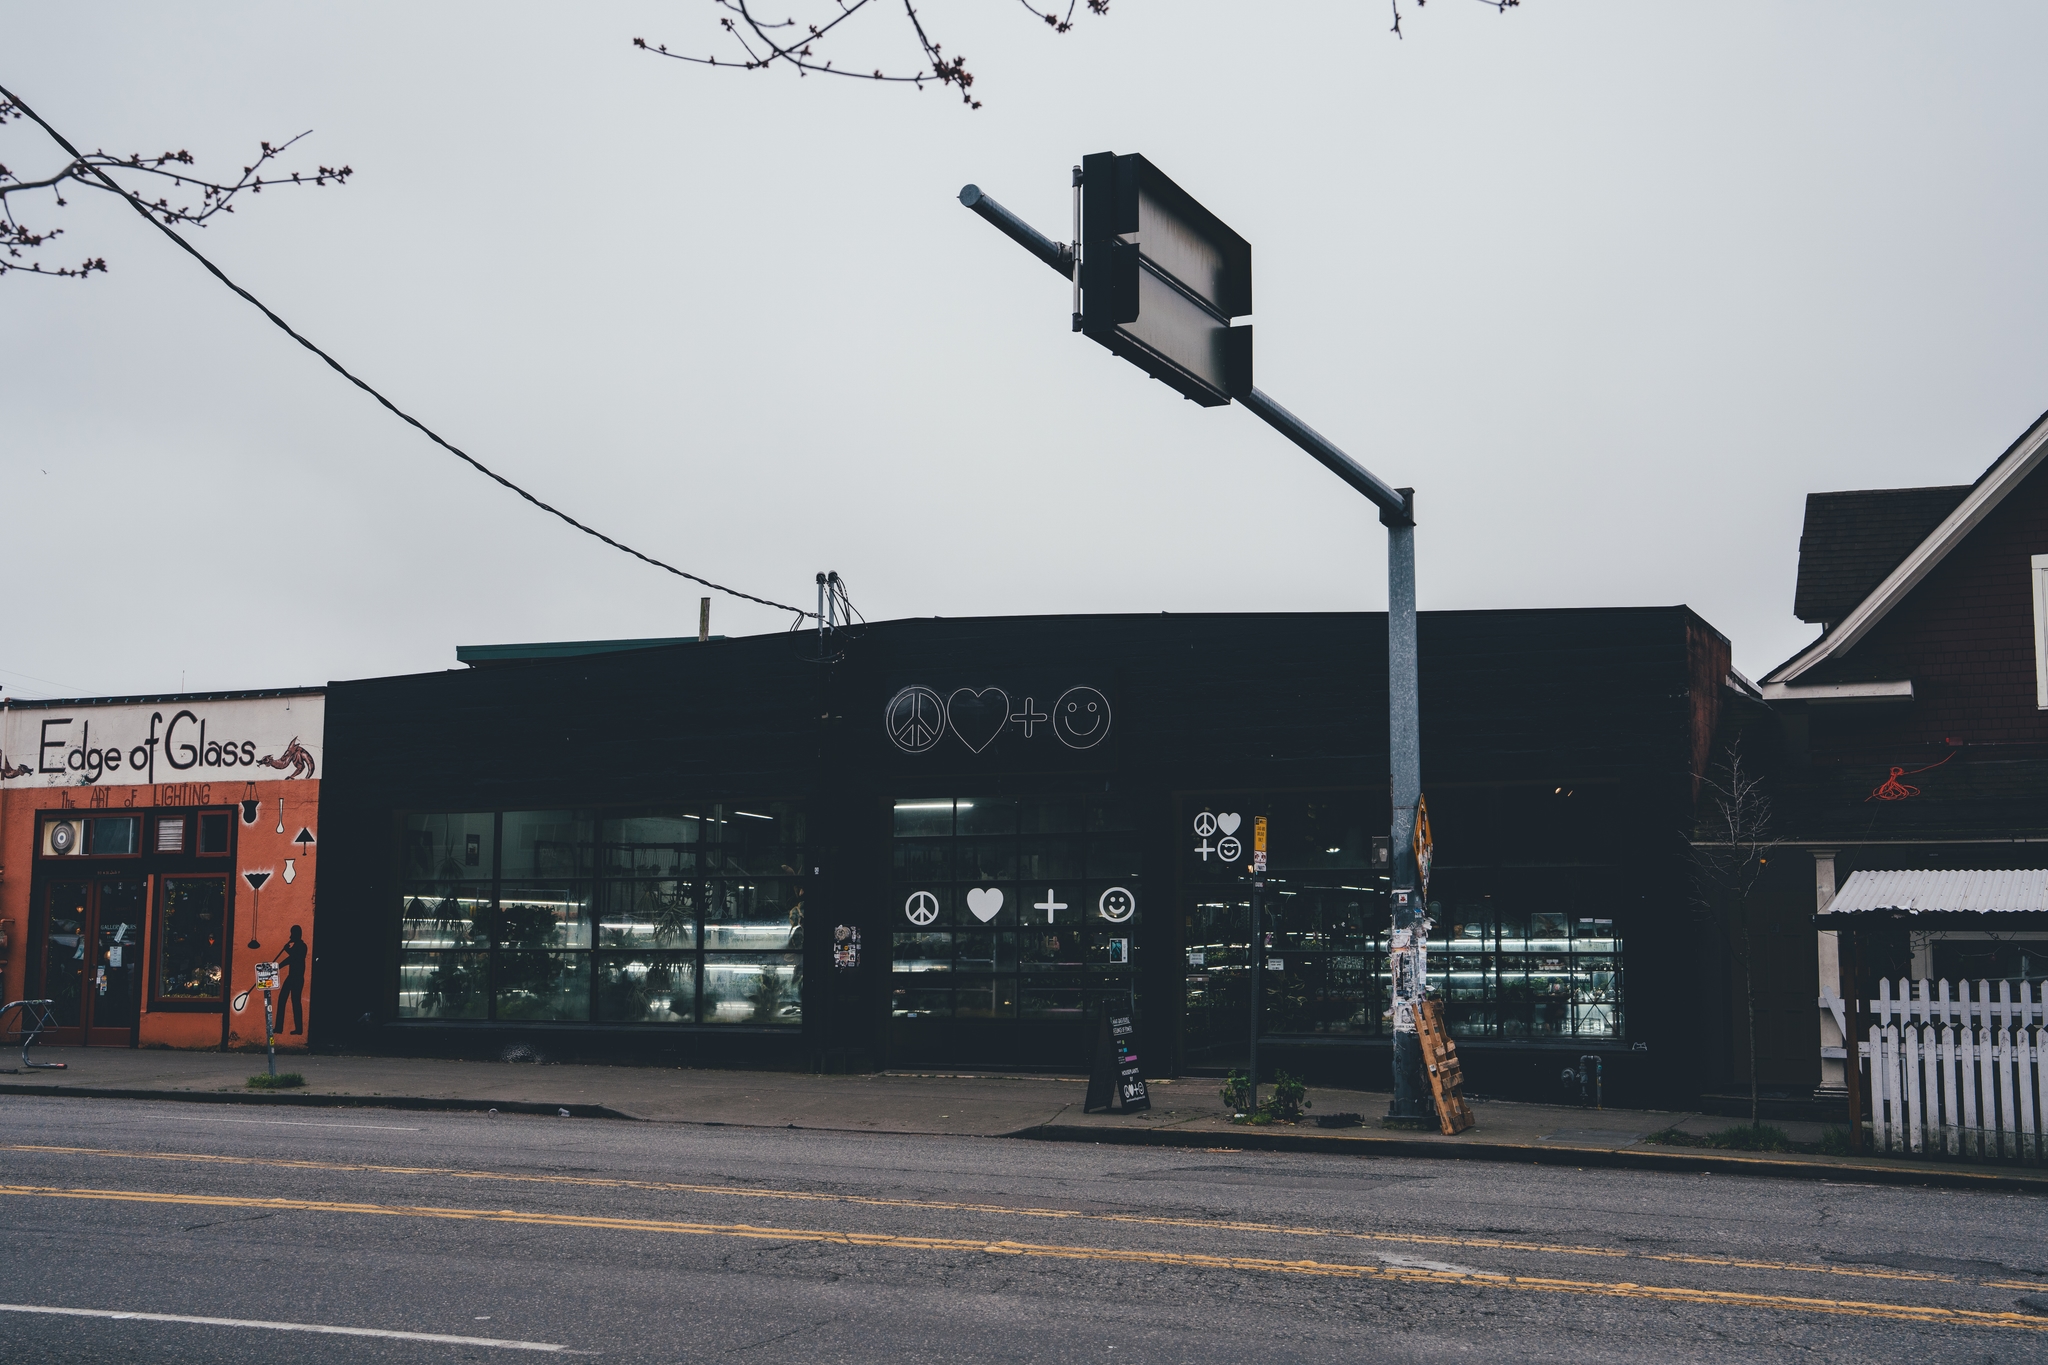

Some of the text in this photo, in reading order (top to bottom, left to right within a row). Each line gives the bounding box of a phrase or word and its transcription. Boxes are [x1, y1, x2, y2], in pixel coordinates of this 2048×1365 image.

[39, 709, 256, 784] Edge of Glass
[90, 785, 111, 808] ART
[153, 782, 211, 807] LIGHTING
